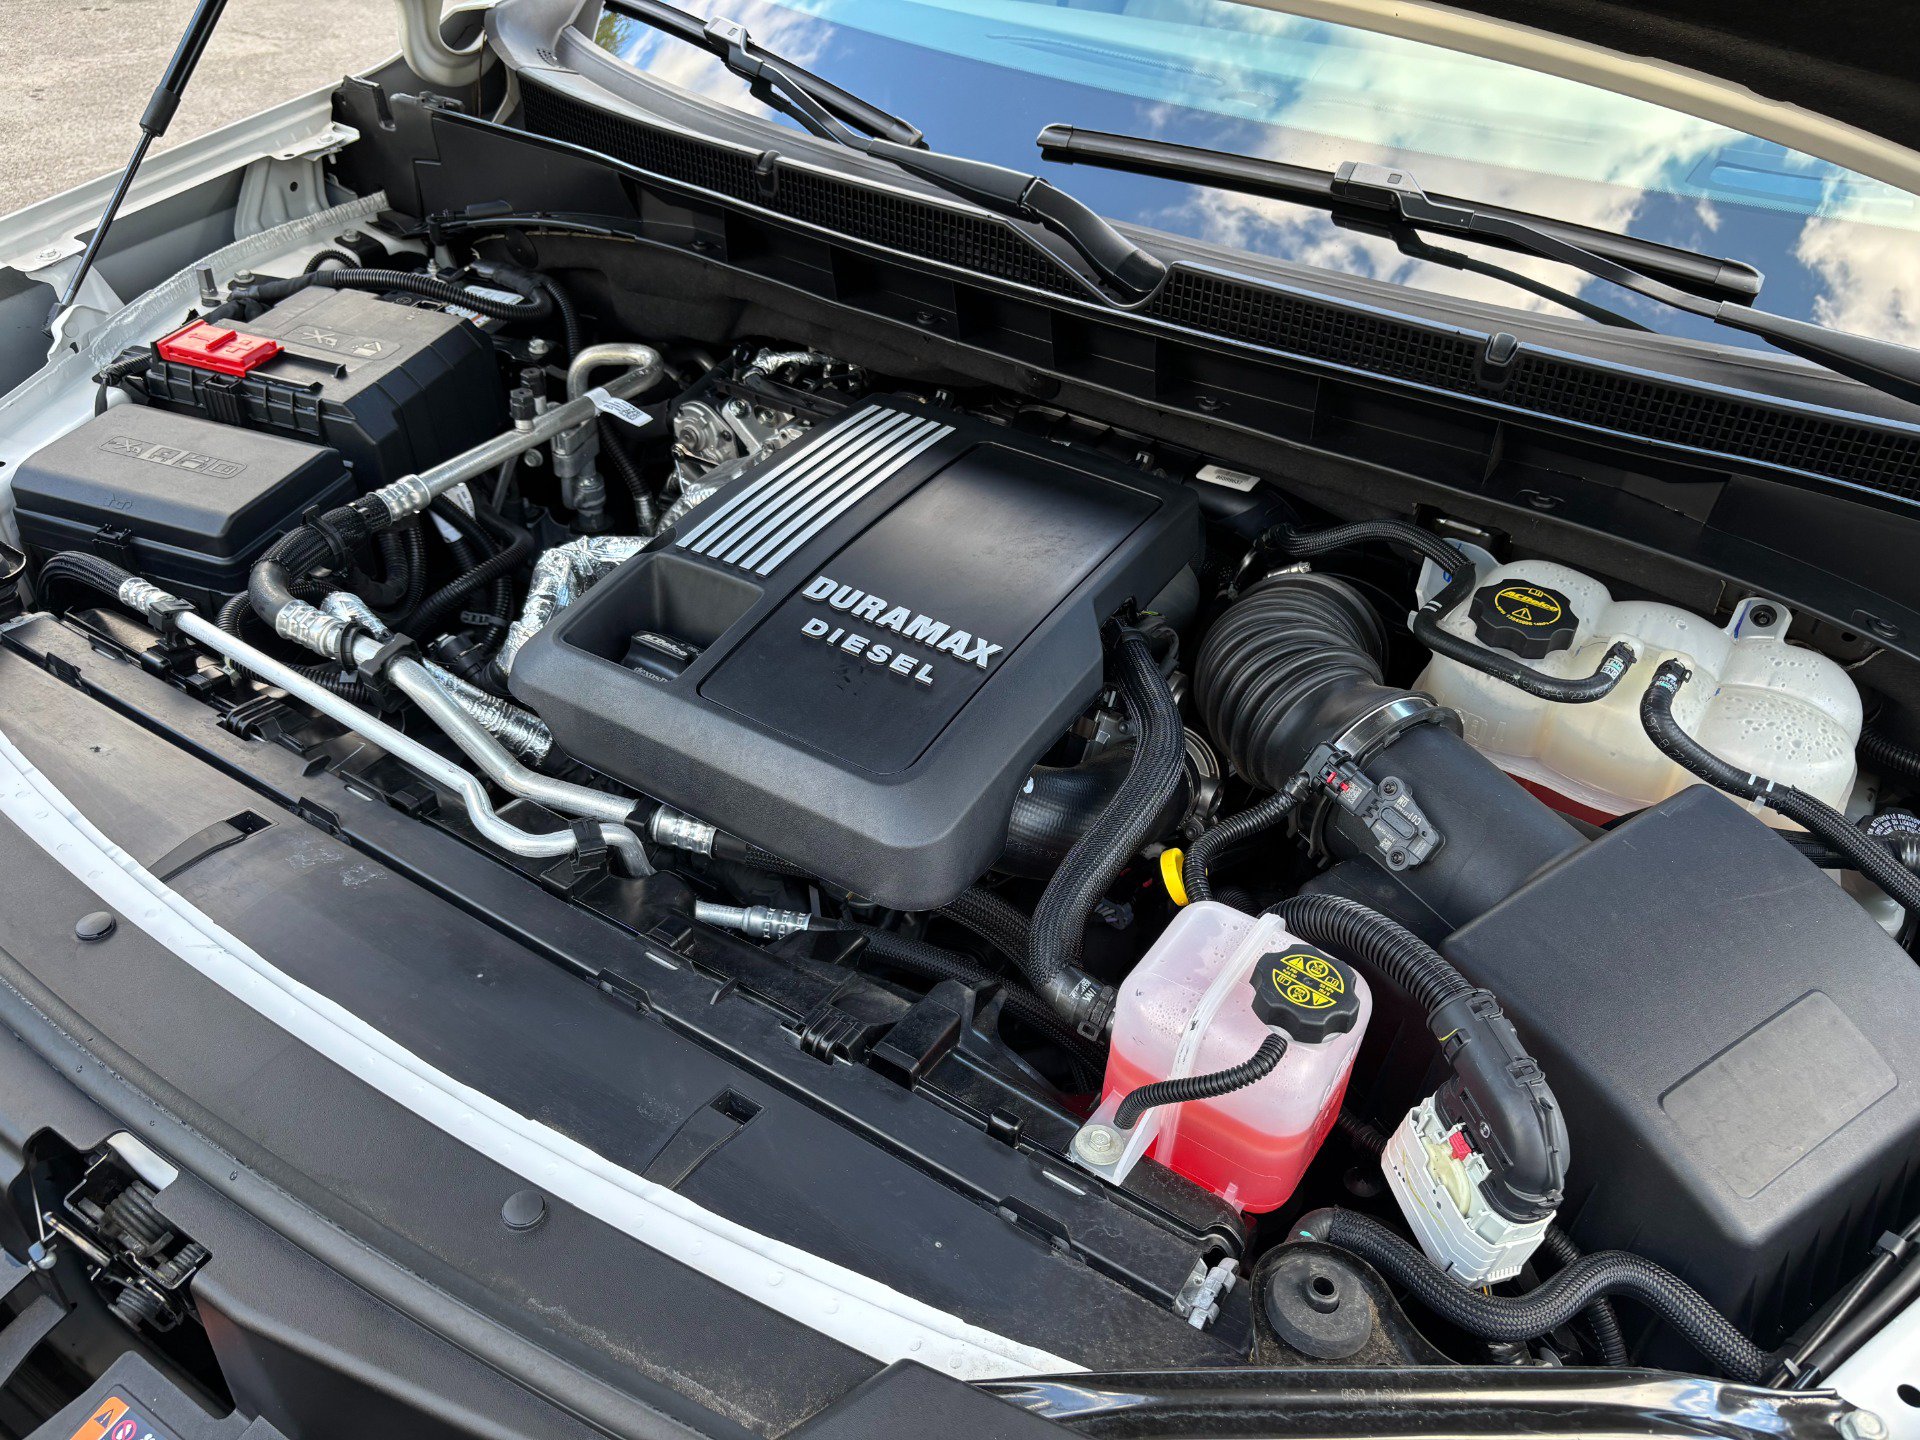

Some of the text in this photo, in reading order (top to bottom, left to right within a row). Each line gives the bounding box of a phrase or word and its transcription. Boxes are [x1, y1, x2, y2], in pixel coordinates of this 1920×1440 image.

[801, 575, 1004, 670] DURAMAX
[1502, 591, 1560, 612] ACDelco
[637, 633, 688, 656] ACDelco
[800, 617, 934, 686] DIESEL
